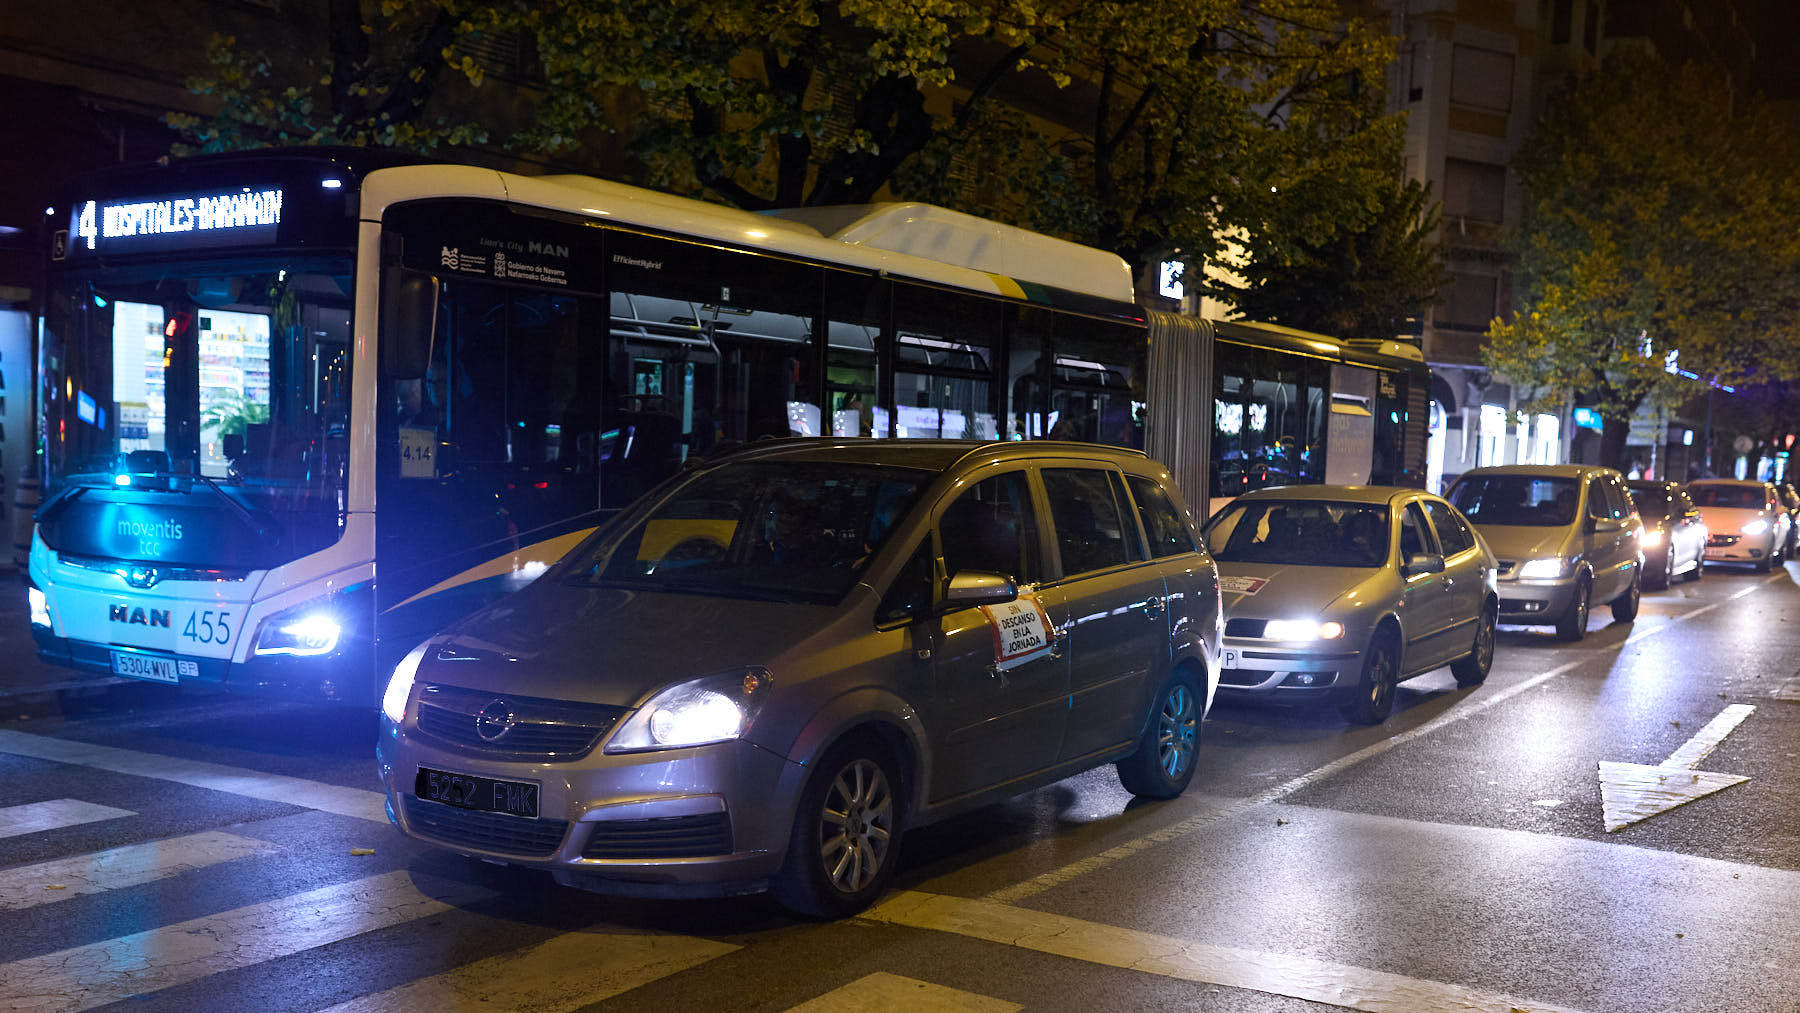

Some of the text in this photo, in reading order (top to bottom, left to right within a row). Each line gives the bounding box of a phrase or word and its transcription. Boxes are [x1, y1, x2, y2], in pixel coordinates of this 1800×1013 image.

[78, 200, 98, 250] 4
[506, 240, 524, 253] City
[528, 241, 570, 258] MAN
[507, 260, 566, 277] Gobierno de Navarra
[403, 446, 432, 461] 4.14
[117, 517, 183, 540] moventis
[139, 538, 161, 556] tcc
[109, 603, 231, 645] MAN 455
[1001, 612, 1036, 630] DESCANSO
[1012, 626, 1031, 639] EN LA
[1008, 635, 1041, 653] JORNADA
